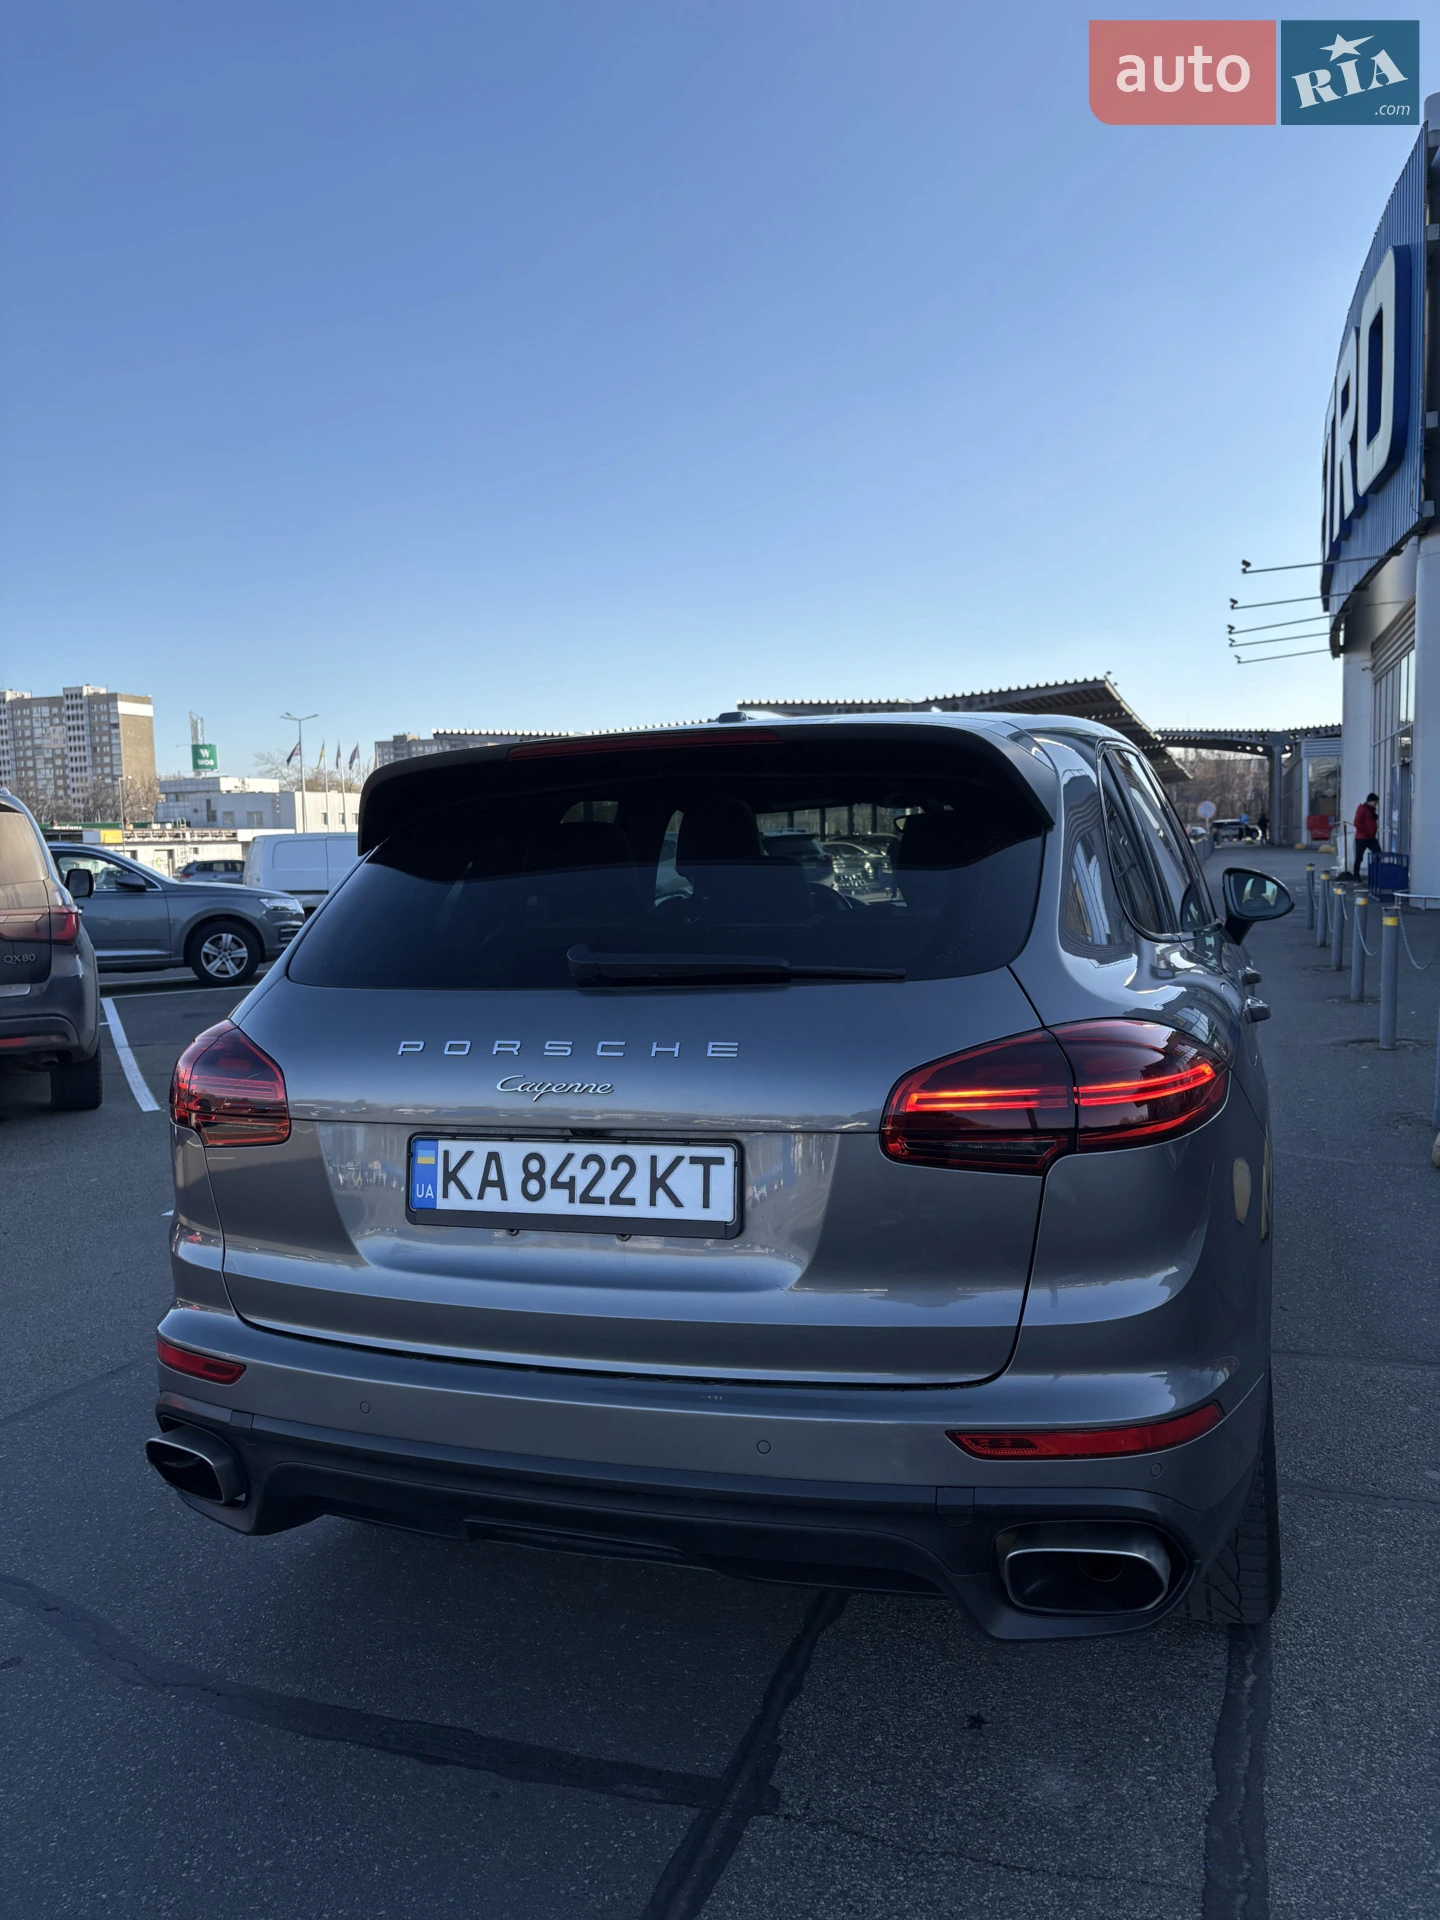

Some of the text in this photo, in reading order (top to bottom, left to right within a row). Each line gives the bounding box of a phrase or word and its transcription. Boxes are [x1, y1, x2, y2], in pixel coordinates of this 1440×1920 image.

[398, 1040, 740, 1058] PORSCHE
[496, 1074, 613, 1102] Cayenne
[416, 1183, 435, 1199] UA
